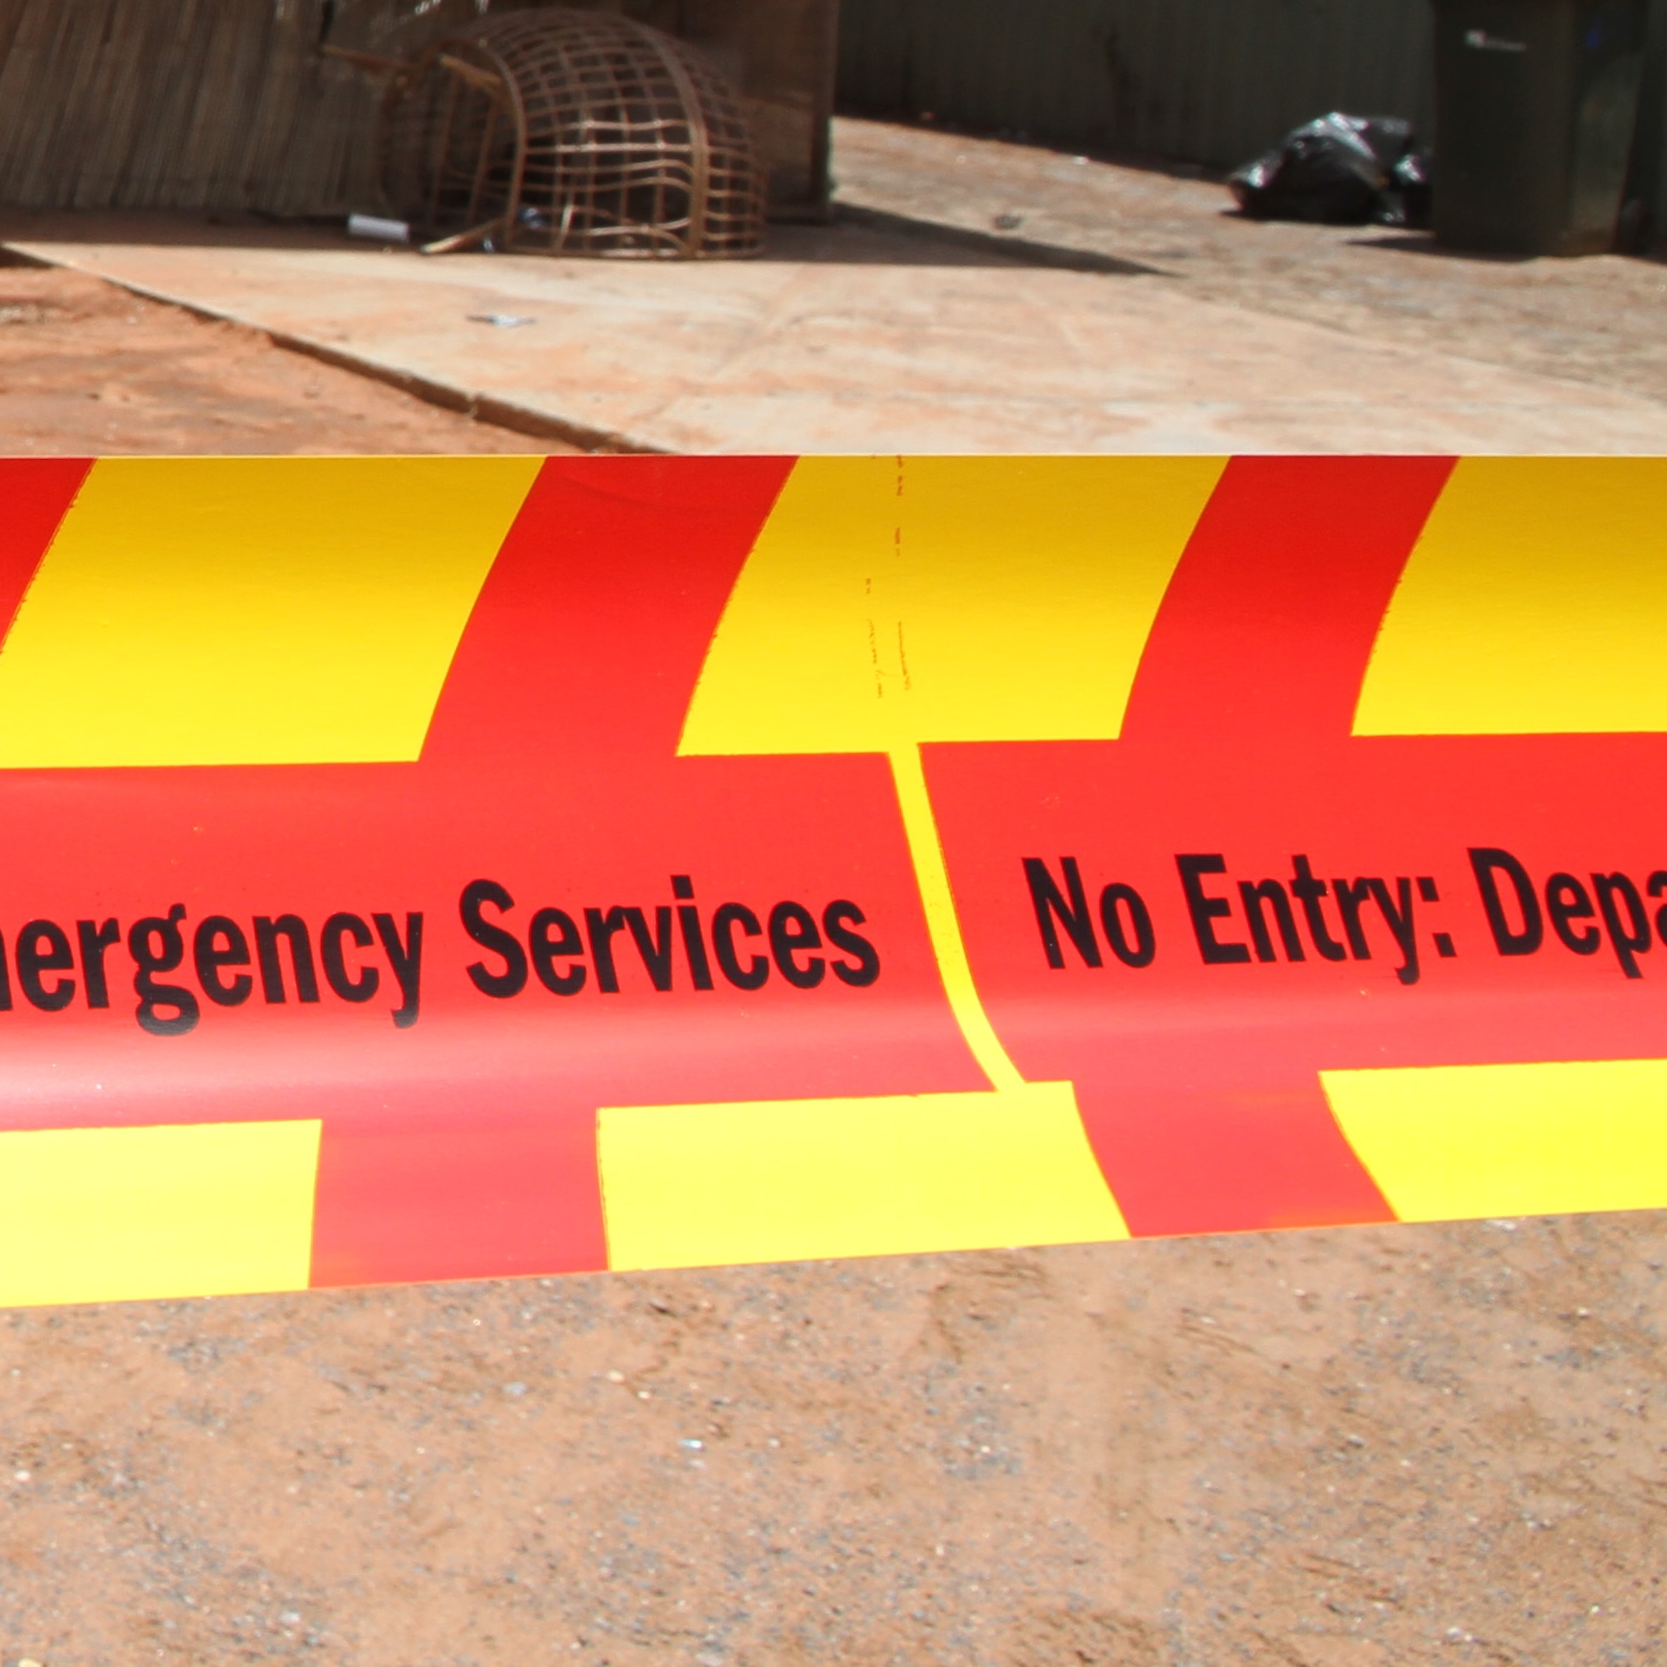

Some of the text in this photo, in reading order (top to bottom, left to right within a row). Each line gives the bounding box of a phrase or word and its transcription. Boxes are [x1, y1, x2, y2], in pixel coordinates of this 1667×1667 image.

[459, 874, 880, 999] Services
[1022, 856, 1156, 970] No
[1175, 853, 1457, 985] Entry:
